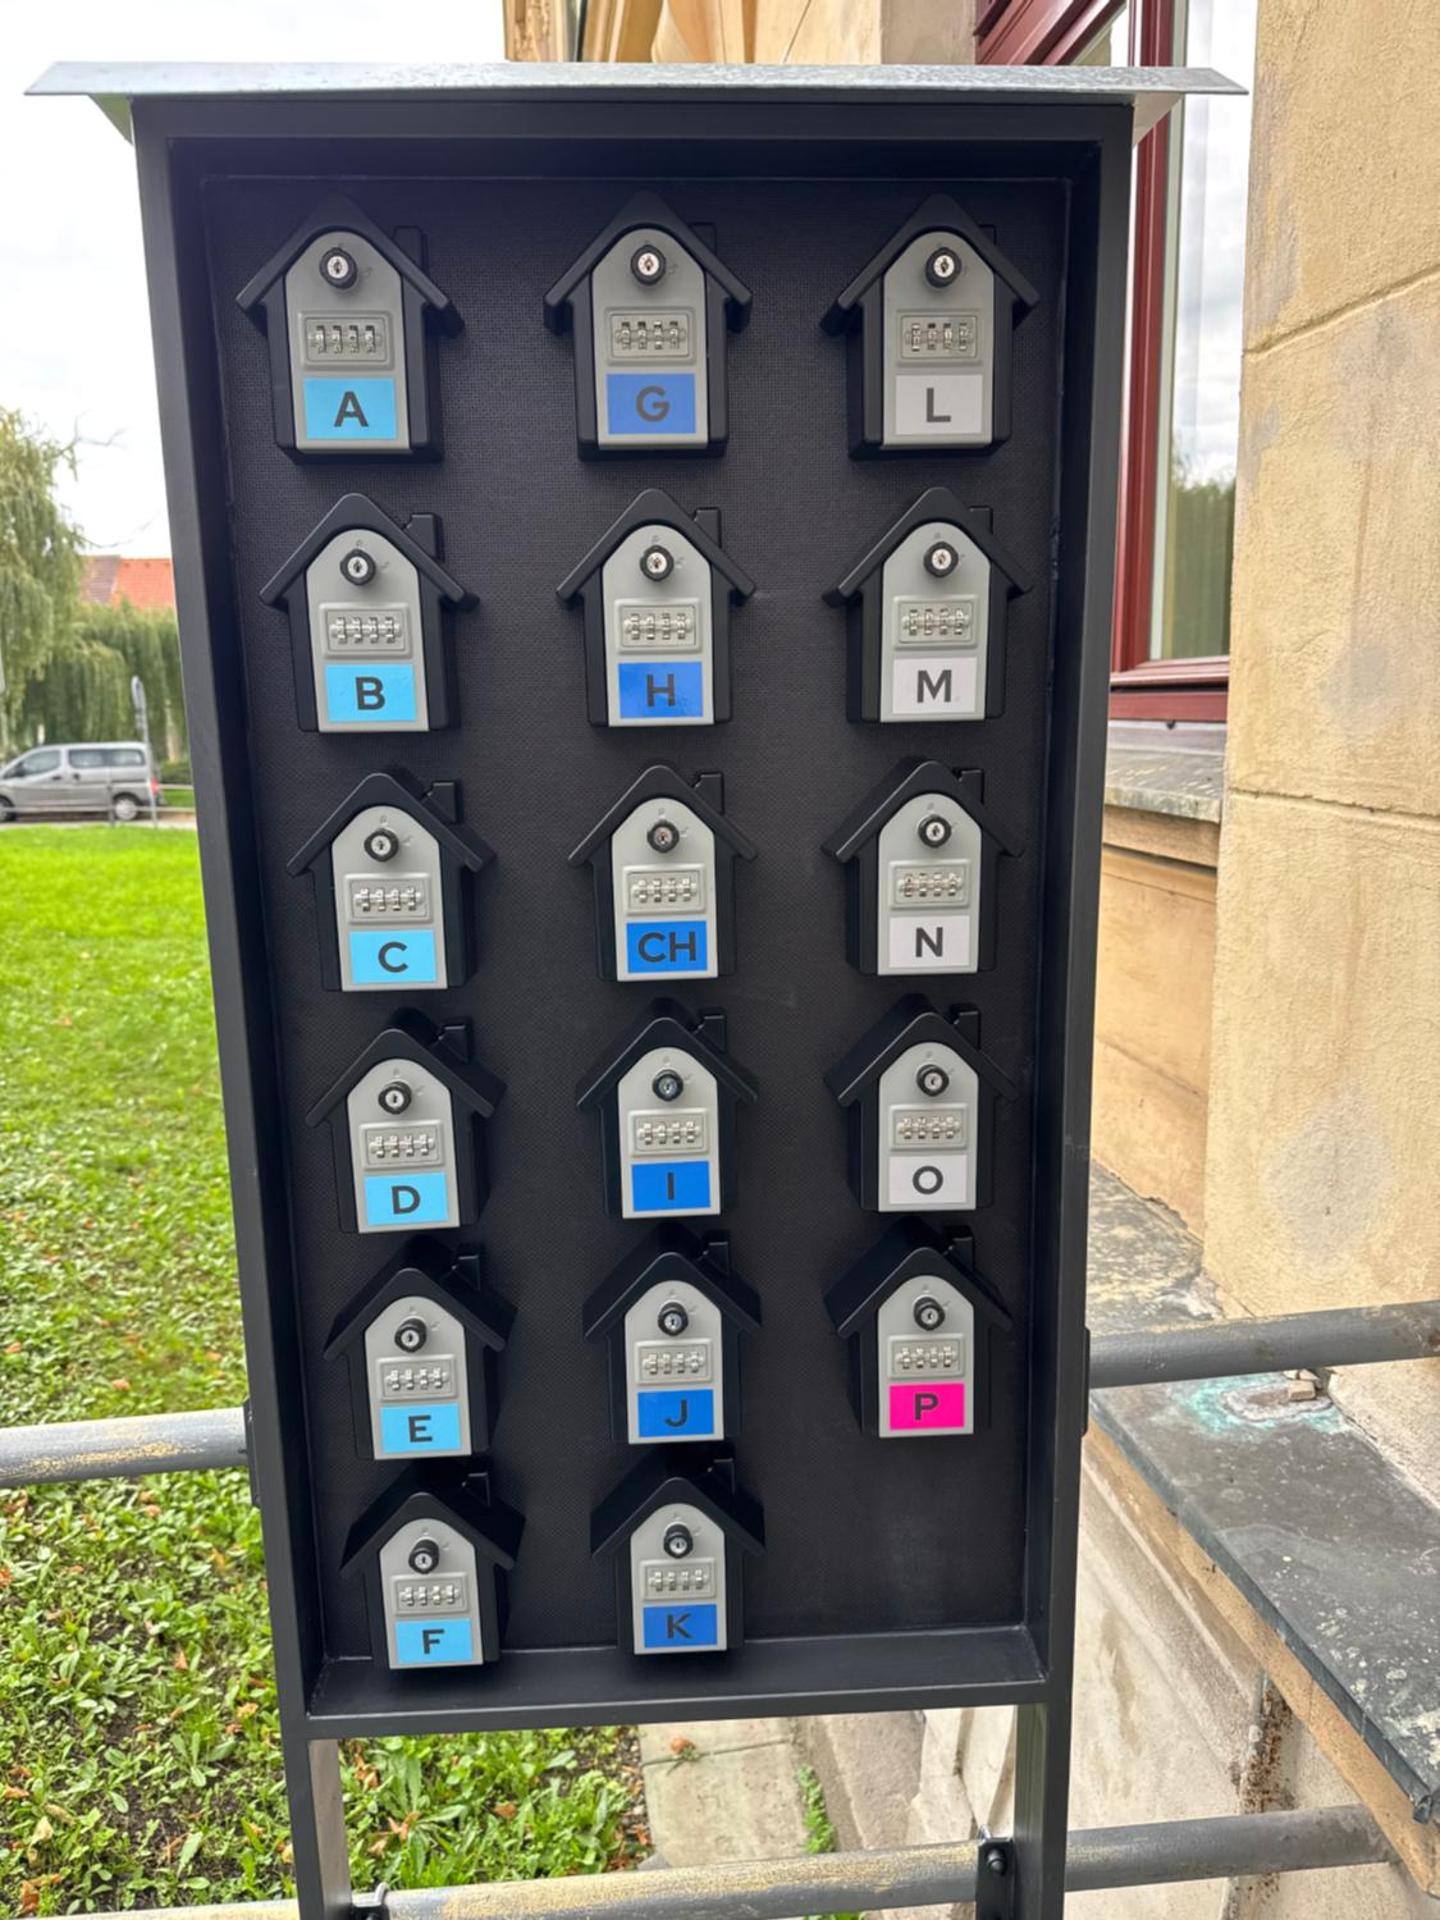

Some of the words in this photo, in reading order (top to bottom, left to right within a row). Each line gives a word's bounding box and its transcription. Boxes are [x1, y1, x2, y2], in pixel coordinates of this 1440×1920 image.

[335, 391, 368, 427] A
[636, 385, 670, 422] G
[927, 388, 951, 422] L
[356, 677, 385, 710] B
[646, 674, 675, 707] H
[917, 670, 952, 703] M
[638, 931, 696, 963] CH
[916, 927, 943, 957] N
[378, 942, 408, 973] C
[666, 1172, 676, 1200] I
[913, 1166, 943, 1194] O
[392, 1186, 420, 1214] D
[665, 1399, 688, 1427] J
[914, 1393, 938, 1421] P
[408, 1414, 432, 1443] E
[422, 1628, 445, 1654] F
[667, 1613, 692, 1639] K
